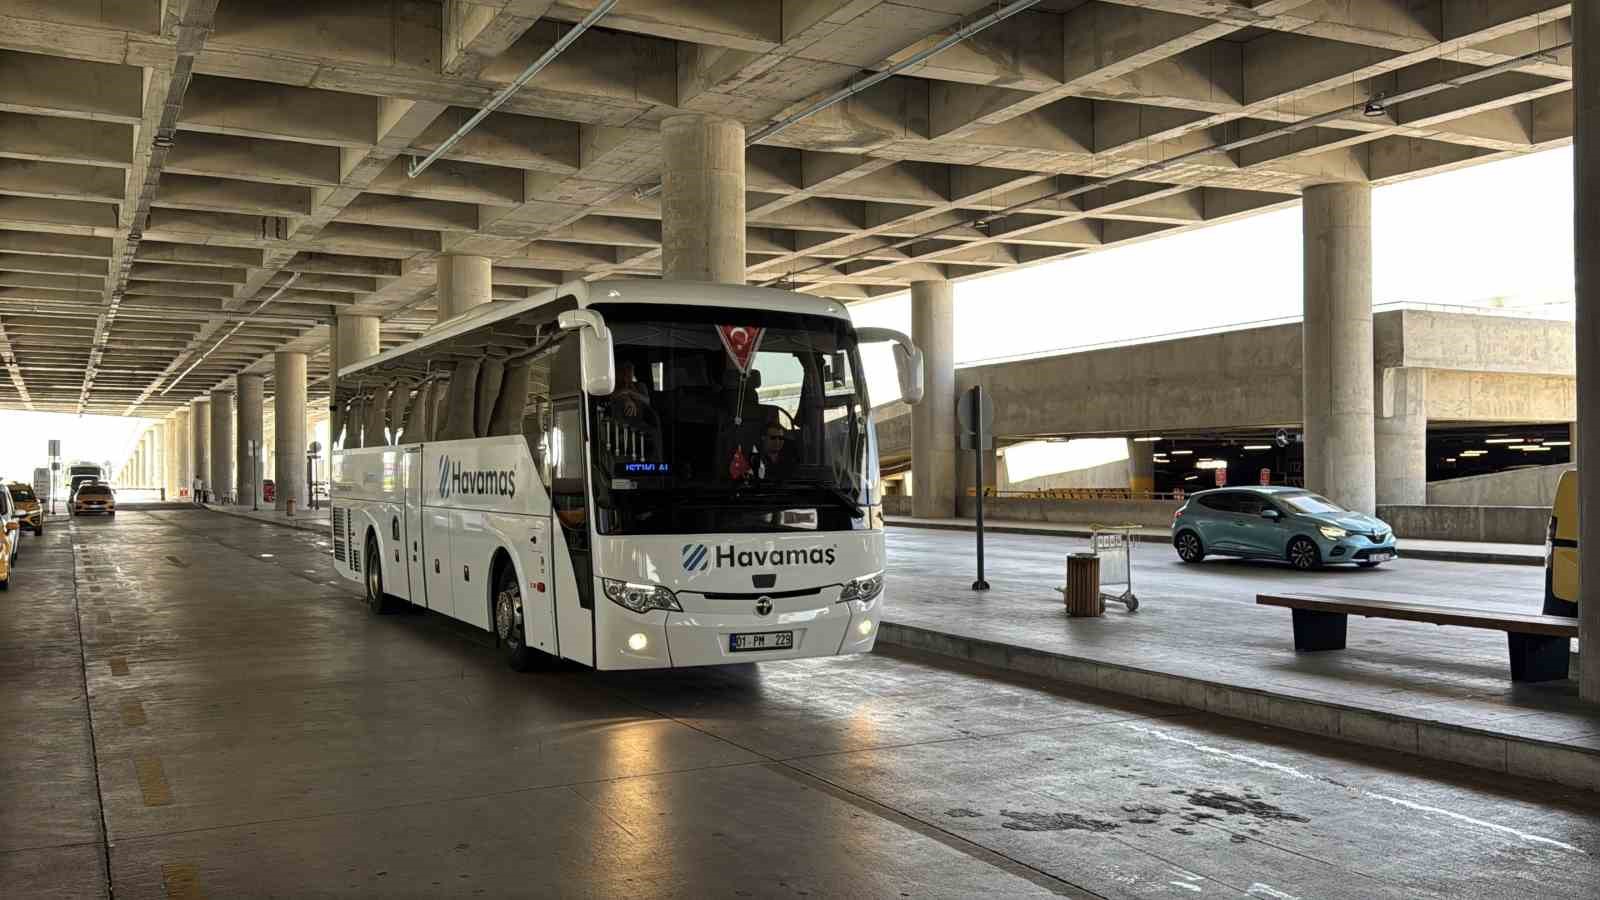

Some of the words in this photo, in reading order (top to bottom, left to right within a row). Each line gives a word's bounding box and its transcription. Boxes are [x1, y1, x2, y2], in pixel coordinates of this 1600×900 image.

[452, 460, 515, 500] Havamaş
[715, 544, 836, 566] Havamaş
[736, 635, 746, 647] 01
